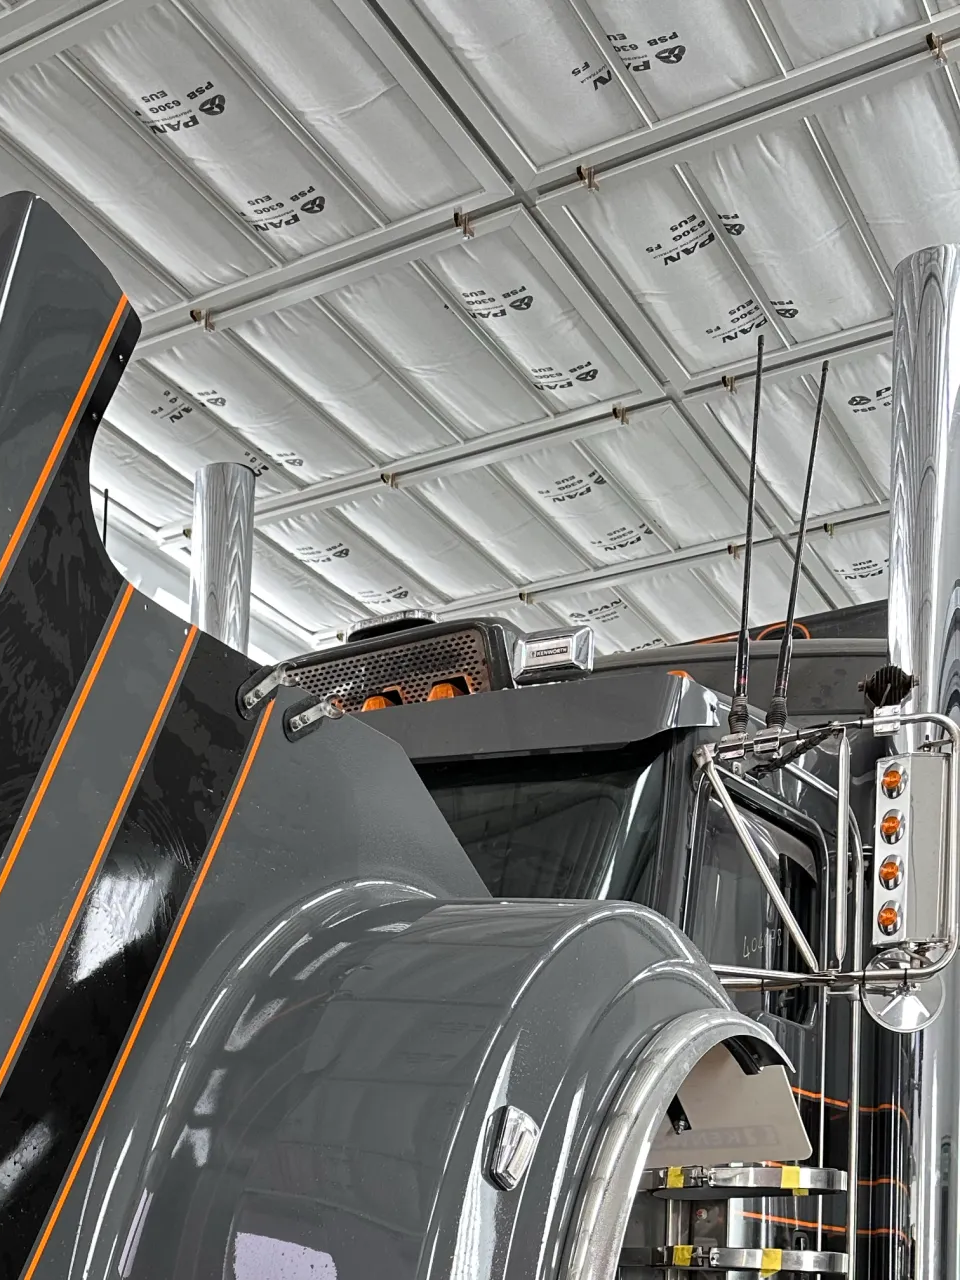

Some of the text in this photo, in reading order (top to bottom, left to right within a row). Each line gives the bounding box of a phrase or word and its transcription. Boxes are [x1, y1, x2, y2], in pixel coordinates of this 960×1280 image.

[607, 33, 627, 42] EU
[647, 32, 679, 46] PSB
[571, 61, 590, 76] F5
[141, 90, 168, 103] EU5
[149, 81, 214, 114] PSB 630G
[150, 115, 200, 134] PAN
[247, 195, 272, 206] EU5
[254, 186, 316, 215] PSB 630G
[253, 213, 301, 232] PAN
[670, 214, 697, 233] EU5
[672, 220, 706, 242] 630G
[664, 232, 715, 266] PAN
[466, 286, 527, 306] PSB 630G
[722, 316, 768, 343] PAN
[568, 361, 592, 373] PSB
[552, 486, 592, 503] PAN
[604, 536, 642, 552] PAN
[845, 569, 883, 580] PAN
[536, 647, 568, 657] KENWORTH
